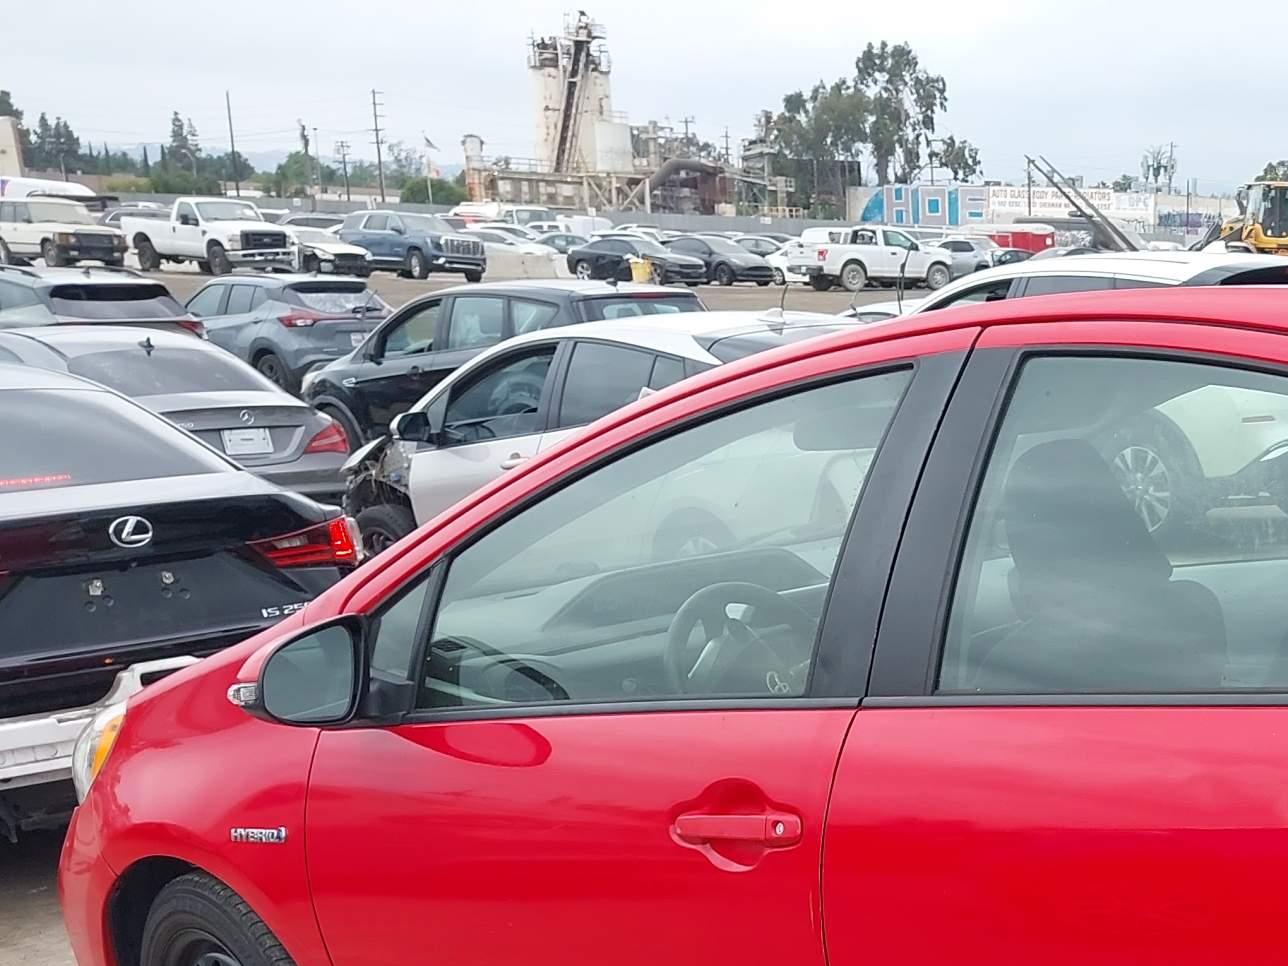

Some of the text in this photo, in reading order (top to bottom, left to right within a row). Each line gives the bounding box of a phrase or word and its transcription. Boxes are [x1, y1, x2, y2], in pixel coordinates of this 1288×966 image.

[992, 189, 1008, 199] AUTO
[261, 602, 309, 618] IS 25
[230, 827, 280, 843] HYBRID
